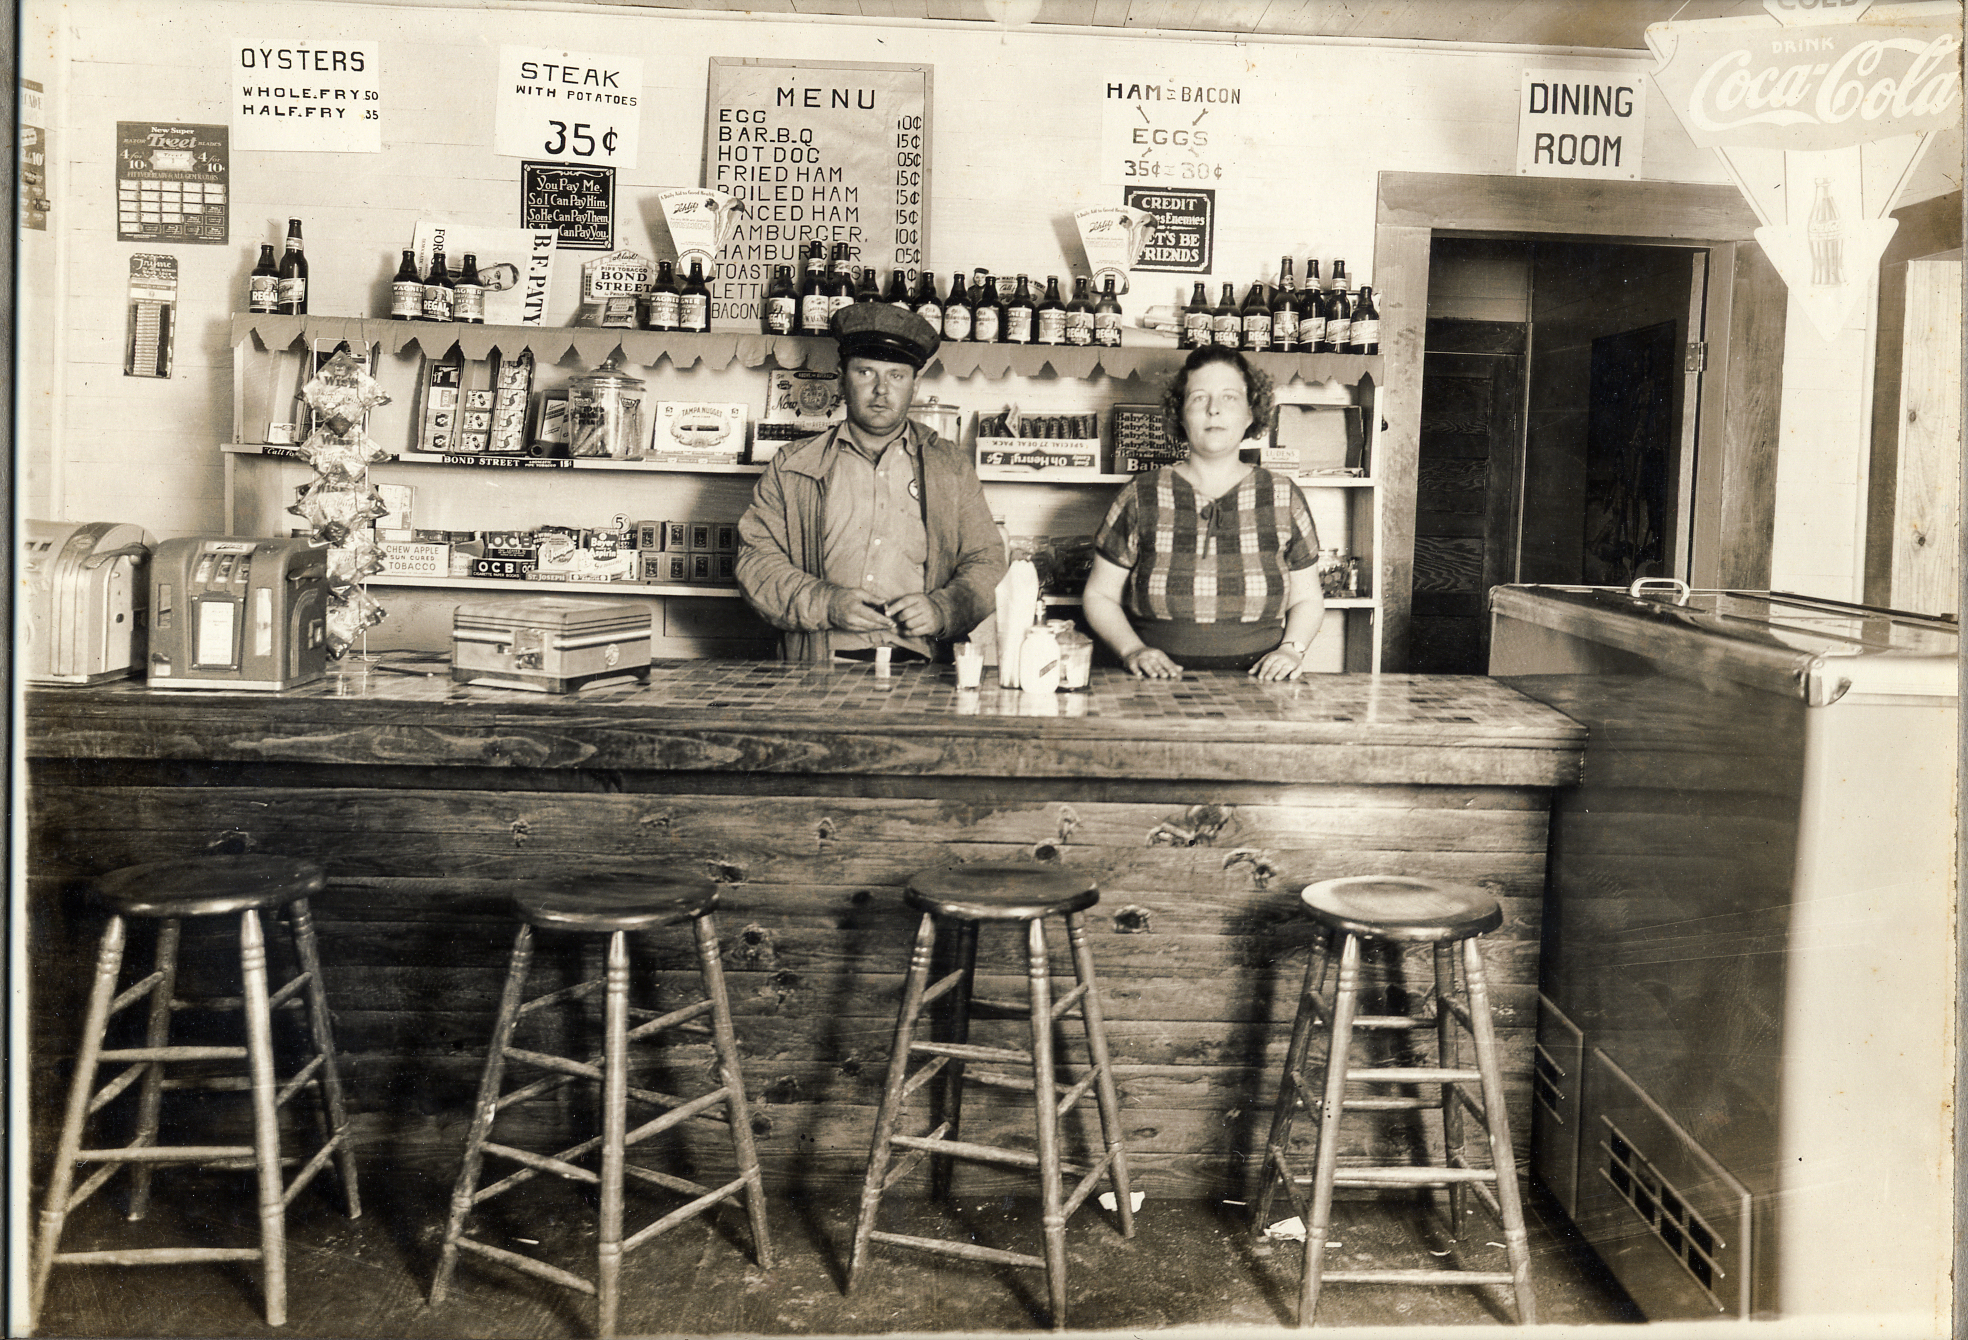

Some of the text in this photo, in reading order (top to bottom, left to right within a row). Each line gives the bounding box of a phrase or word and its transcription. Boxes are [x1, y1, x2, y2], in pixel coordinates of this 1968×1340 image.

[1771, 37, 1834, 54] DRINK
[241, 48, 365, 72] OYSTERS
[521, 61, 620, 88] STEAK
[1688, 33, 1960, 132] Coca-Cola
[516, 85, 637, 106] WITH POTATOES
[777, 87, 875, 109] MENU
[1106, 83, 1241, 104] HAM BACON
[1529, 82, 1633, 118] DINING
[720, 109, 922, 131] EGG 10¢
[171, 127, 195, 135] Super
[544, 120, 618, 156] 35¢
[1133, 128, 1209, 146] EGGS
[146, 133, 197, 148] Treet
[897, 134, 921, 149] 15¢
[120, 149, 129, 160] 4
[197, 152, 207, 162] 4
[718, 145, 922, 167] HOT DOG 05¢
[1534, 133, 1622, 167] ROOM
[717, 165, 921, 187] FRIED HAM 15¢
[1125, 160, 1223, 181] 35¢ 30¢
[537, 175, 559, 191] You
[559, 178, 580, 193] Pay
[528, 192, 543, 205] So
[550, 194, 569, 206] Can
[570, 194, 587, 209] Pay
[717, 184, 920, 206] BOILED HAM 15¢
[1141, 197, 1198, 210] CREDIT
[528, 208, 541, 221] So
[541, 208, 553, 221] He
[553, 209, 571, 222] Can
[571, 210, 588, 224] Pay
[741, 205, 919, 225] NCED HAM 15¢
[1166, 212, 1205, 225] Enemies
[432, 228, 446, 252] FOR
[559, 224, 575, 237] Can
[575, 224, 590, 240] Pay
[896, 229, 919, 245] 10¢
[1148, 231, 1200, 247] ET'S BE
[895, 249, 921, 264] 05¢
[601, 272, 647, 282] BOND
[595, 282, 652, 292] STREET
[712, 283, 772, 299] LETTU
[523, 275, 547, 326] PATY
[772, 394, 798, 411] Now
[682, 406, 722, 418] TAMPA NUGGET
[444, 456, 520, 467] BOND STREET
[987, 452, 1004, 465] 5¢
[1011, 454, 1067, 466] Oh Henry!
[492, 535, 533, 548] OCB
[591, 538, 615, 548] Bayer
[386, 545, 440, 555] CHEW APPLE
[590, 548, 616, 559] Aspirin
[389, 561, 436, 571] TOBACCO
[479, 562, 514, 573] OCB
[538, 574, 565, 582] JOSEPH
